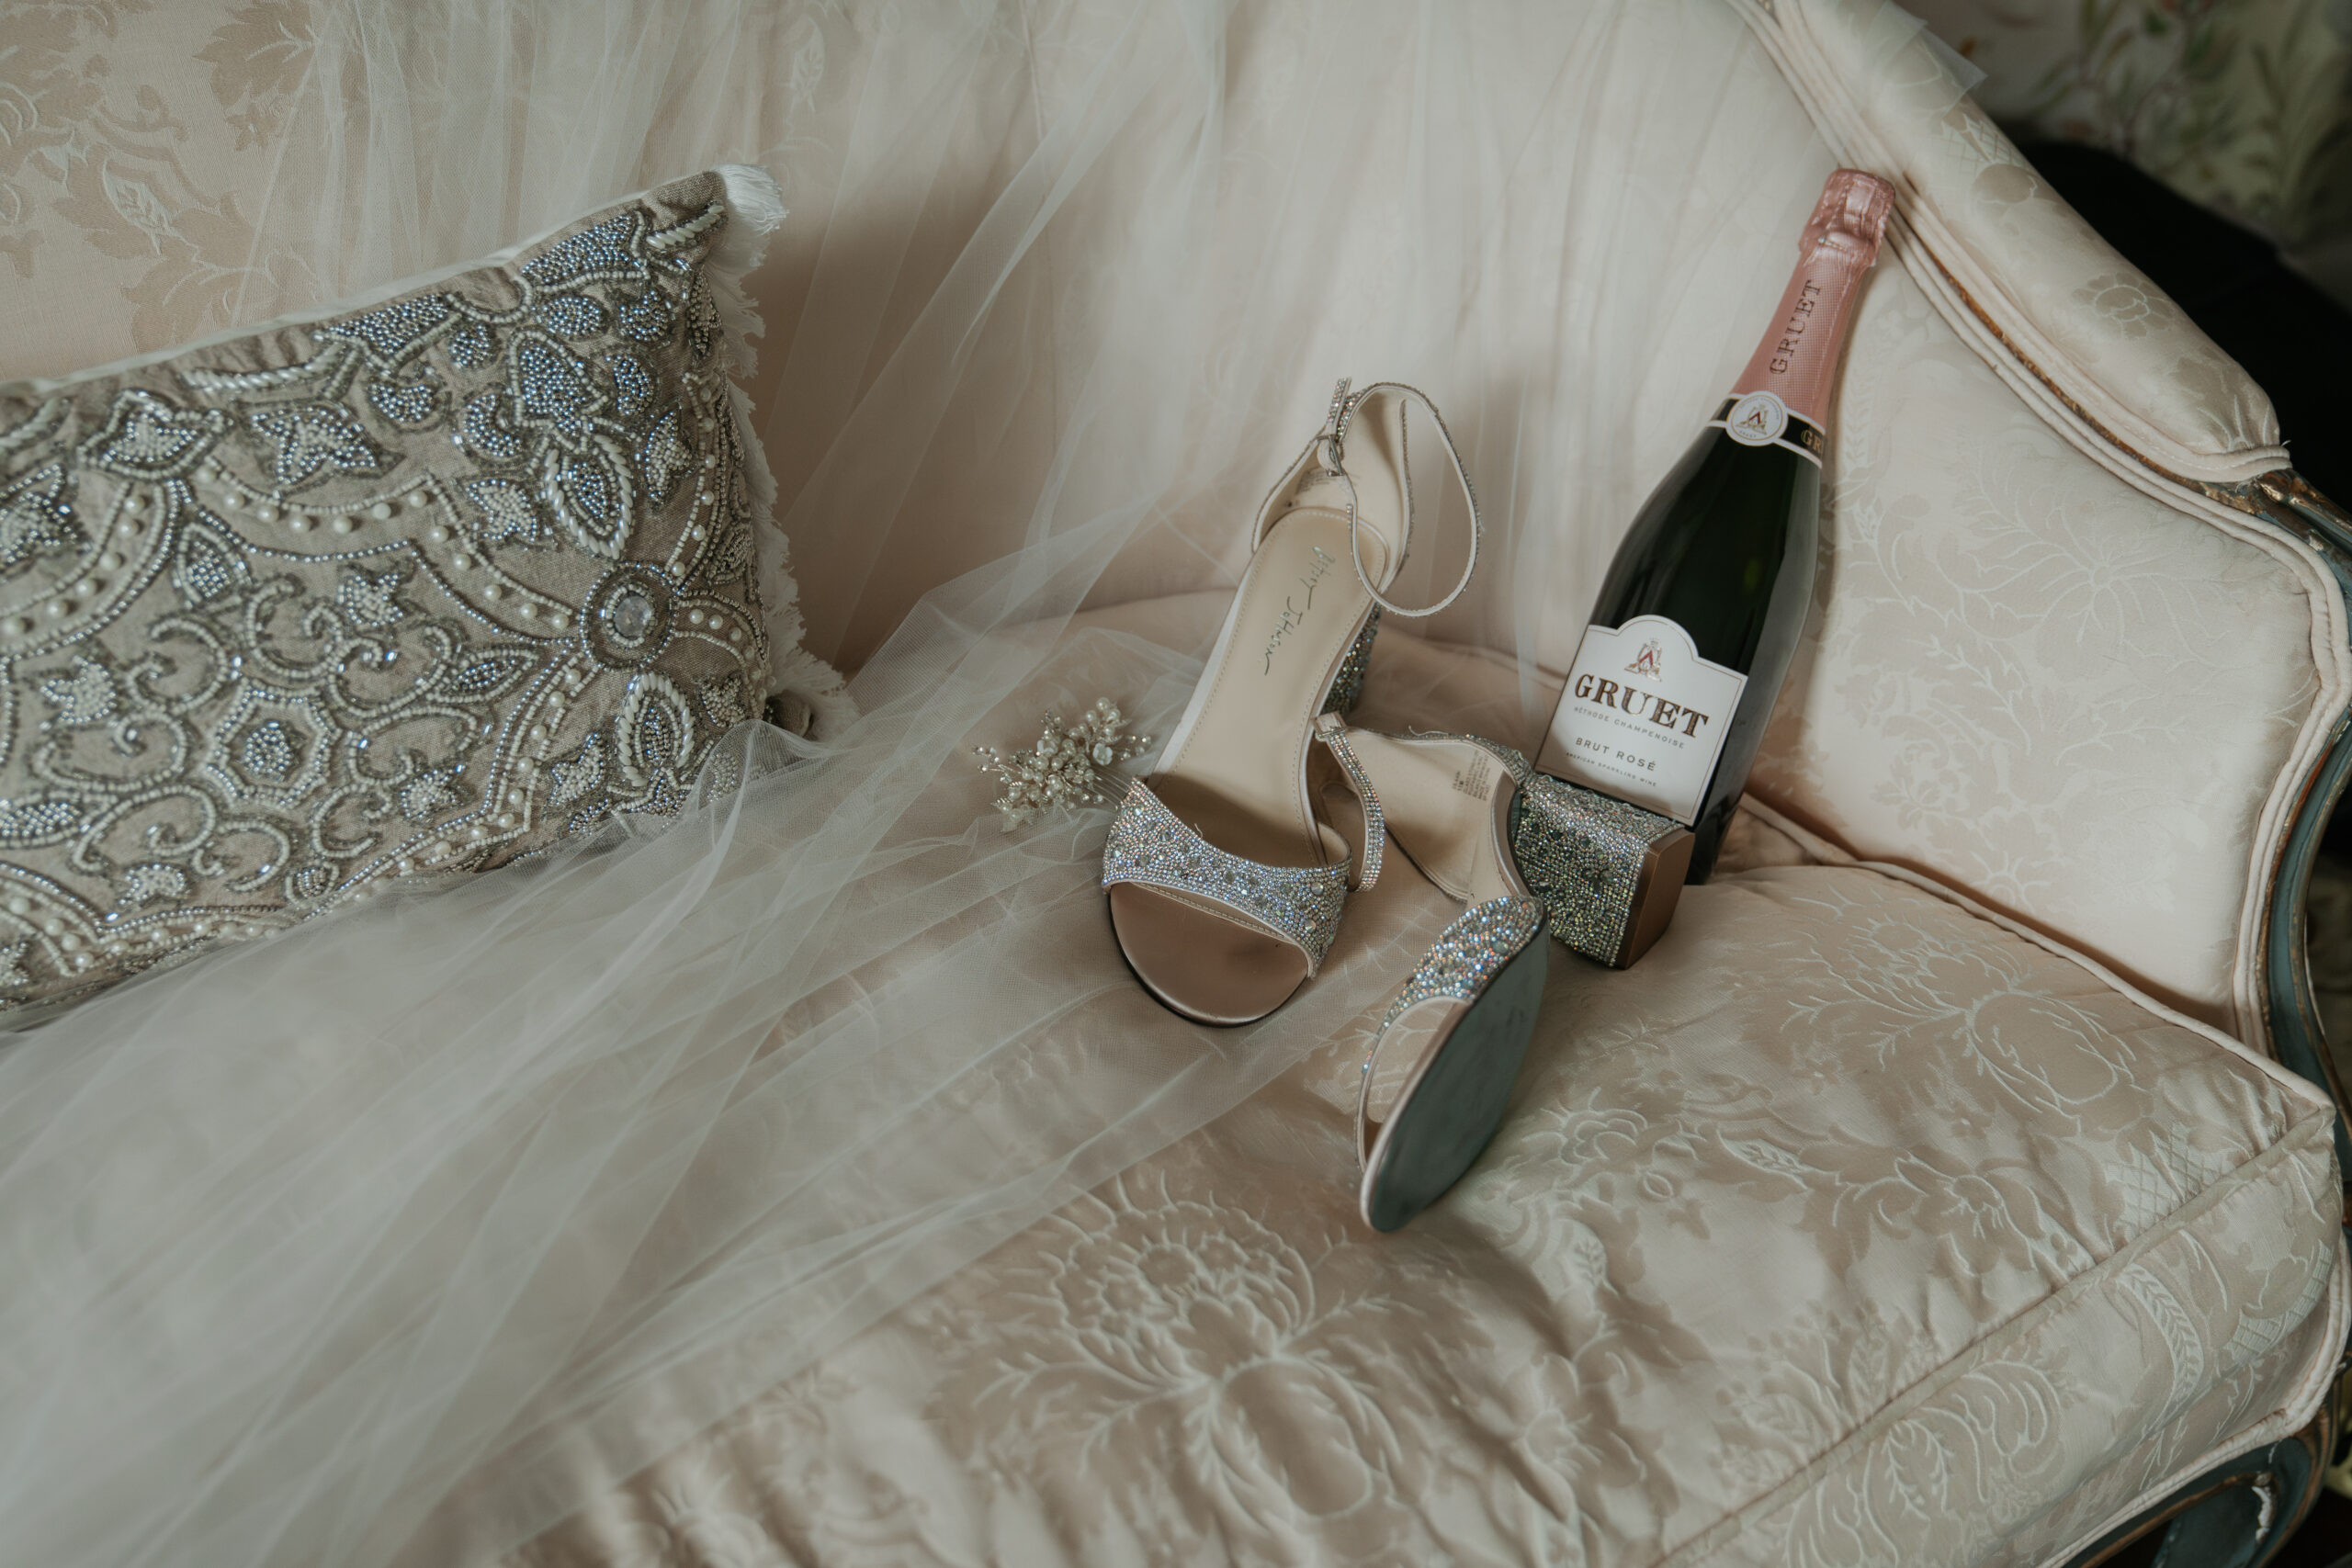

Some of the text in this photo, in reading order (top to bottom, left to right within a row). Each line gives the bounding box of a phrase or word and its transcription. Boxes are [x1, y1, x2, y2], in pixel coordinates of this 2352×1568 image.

[1770, 279, 1821, 375] GRUET
[1574, 673, 1710, 738] GRUET
[1574, 706, 1685, 749] MÉTHODE CHAMPENOISE
[1575, 737, 1657, 771] BRUT ROSÉ
[1640, 778, 1657, 787] WINE
